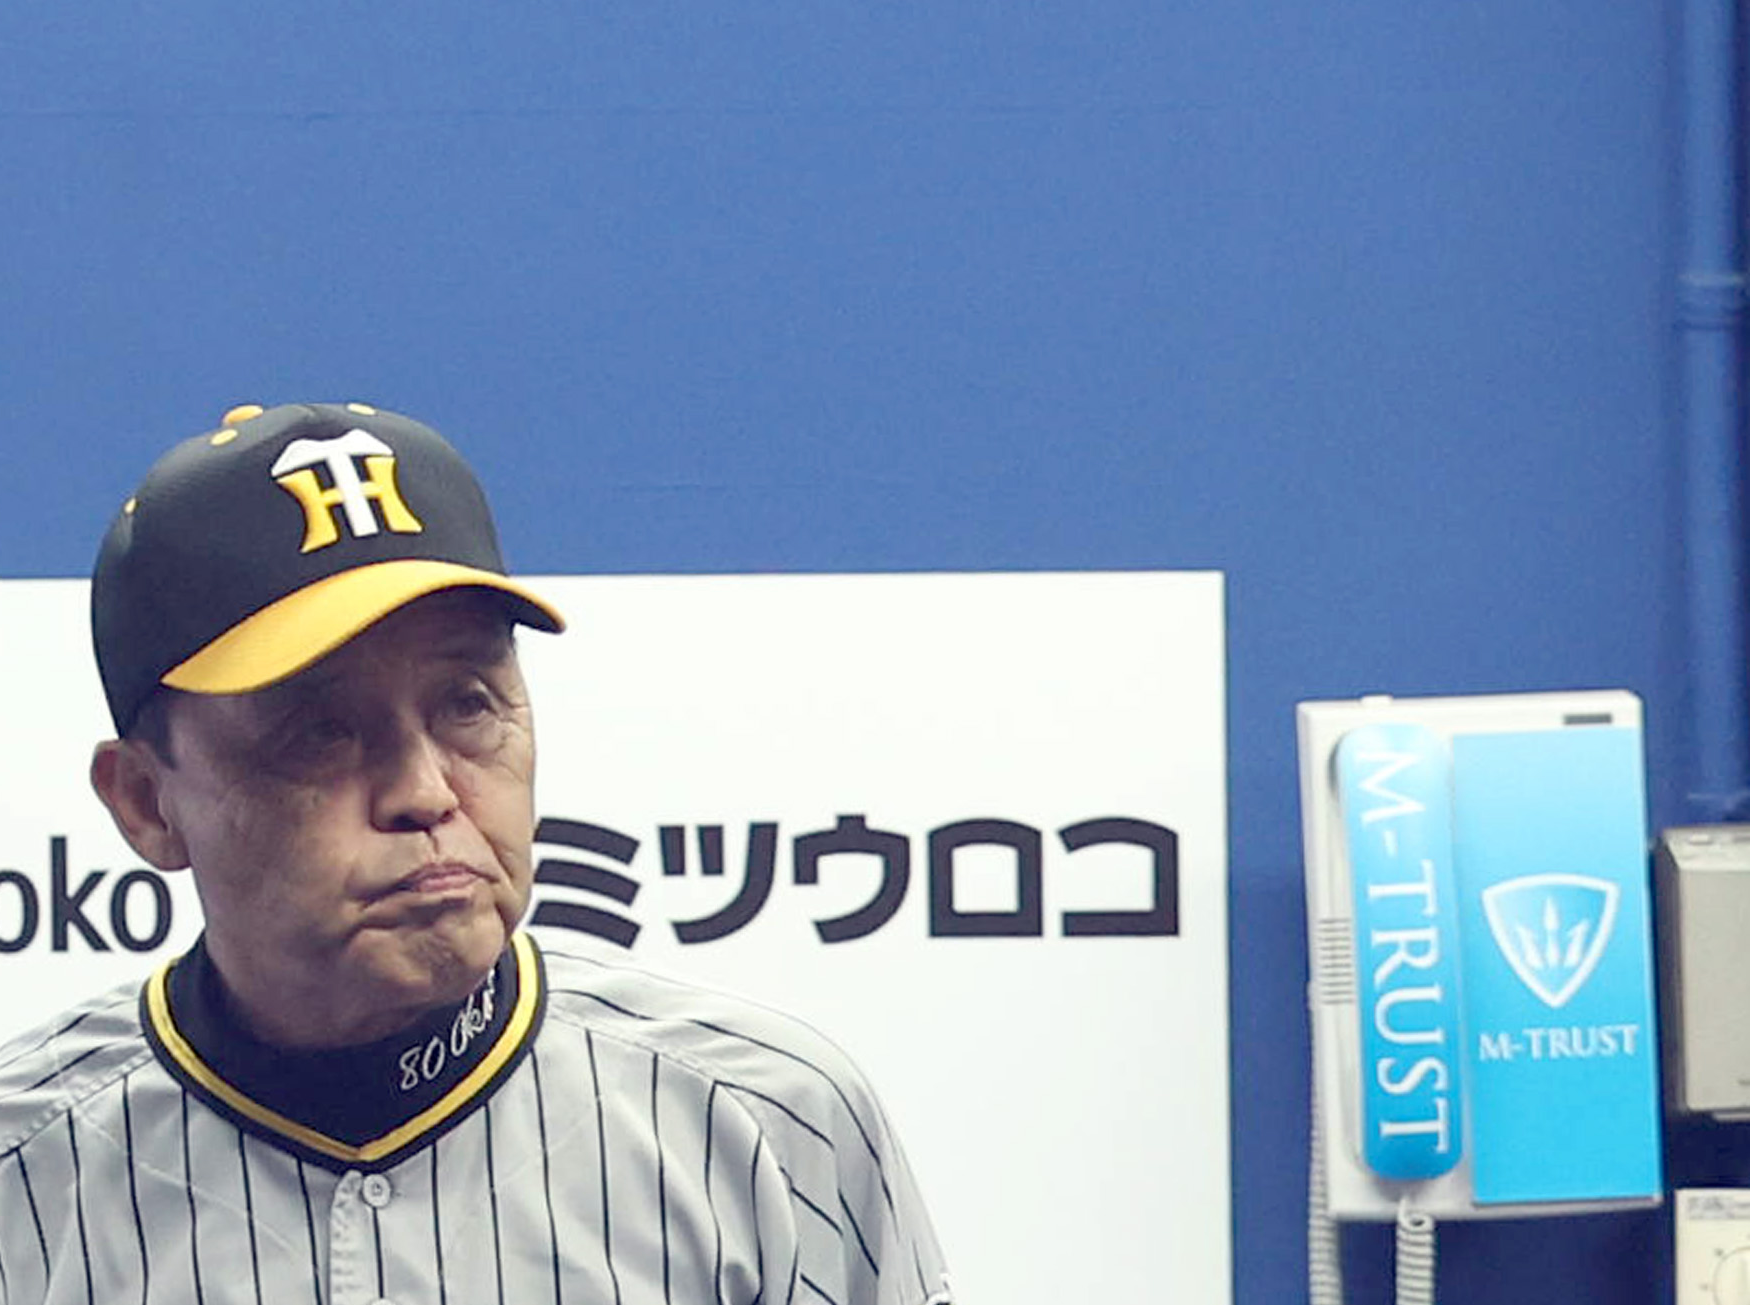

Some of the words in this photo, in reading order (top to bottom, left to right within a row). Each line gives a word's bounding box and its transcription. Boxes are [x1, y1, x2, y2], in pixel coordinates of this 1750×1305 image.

[529, 814, 1180, 950] ミツウロコ
[1355, 749, 1449, 1156] M-TRUST
[1478, 1024, 1639, 1061] M-TRUST
